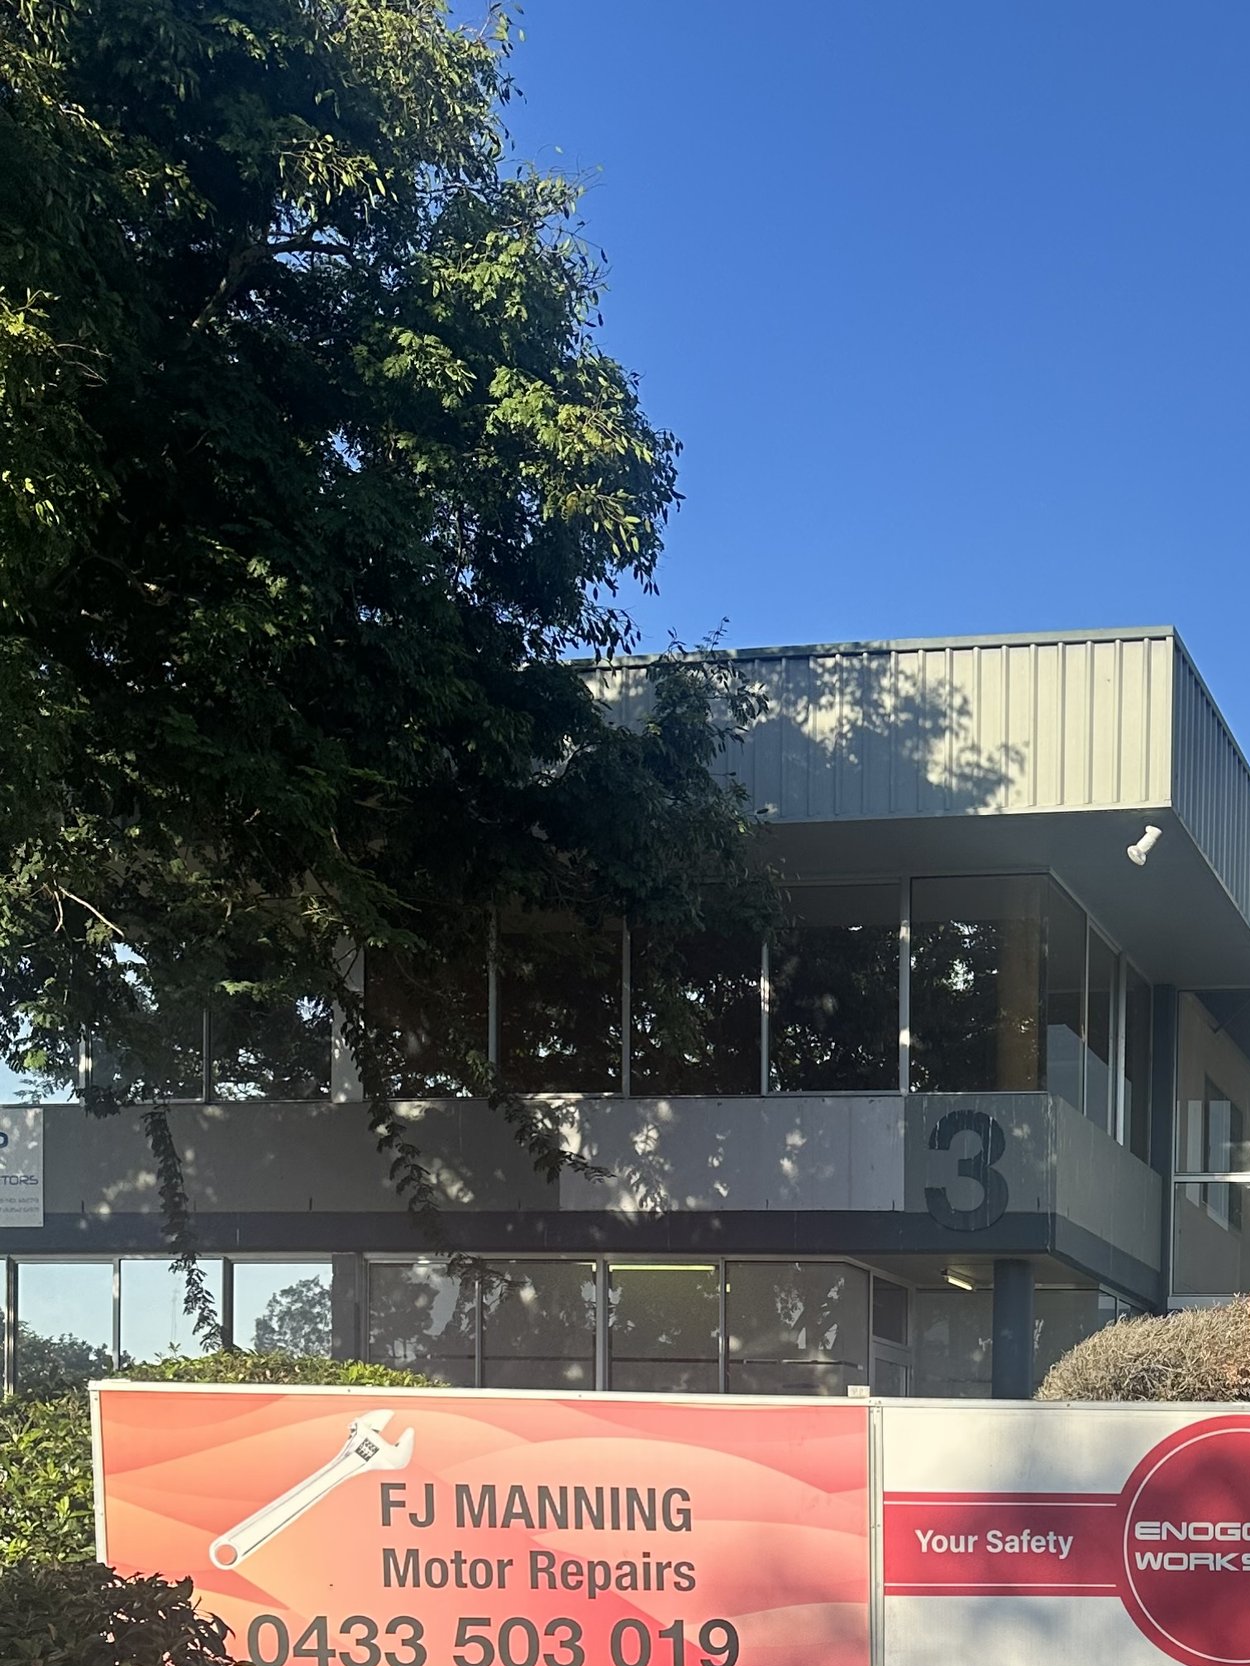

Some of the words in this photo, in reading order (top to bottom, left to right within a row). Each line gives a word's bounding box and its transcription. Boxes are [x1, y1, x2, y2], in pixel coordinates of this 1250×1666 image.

[924, 1108, 1009, 1232] 3
[380, 1482, 435, 1528] FJ
[454, 1483, 692, 1532] MANNING
[914, 1529, 978, 1553] Your
[986, 1529, 1074, 1560] Safety
[382, 1547, 513, 1589] Motor
[529, 1550, 696, 1600] Repairs
